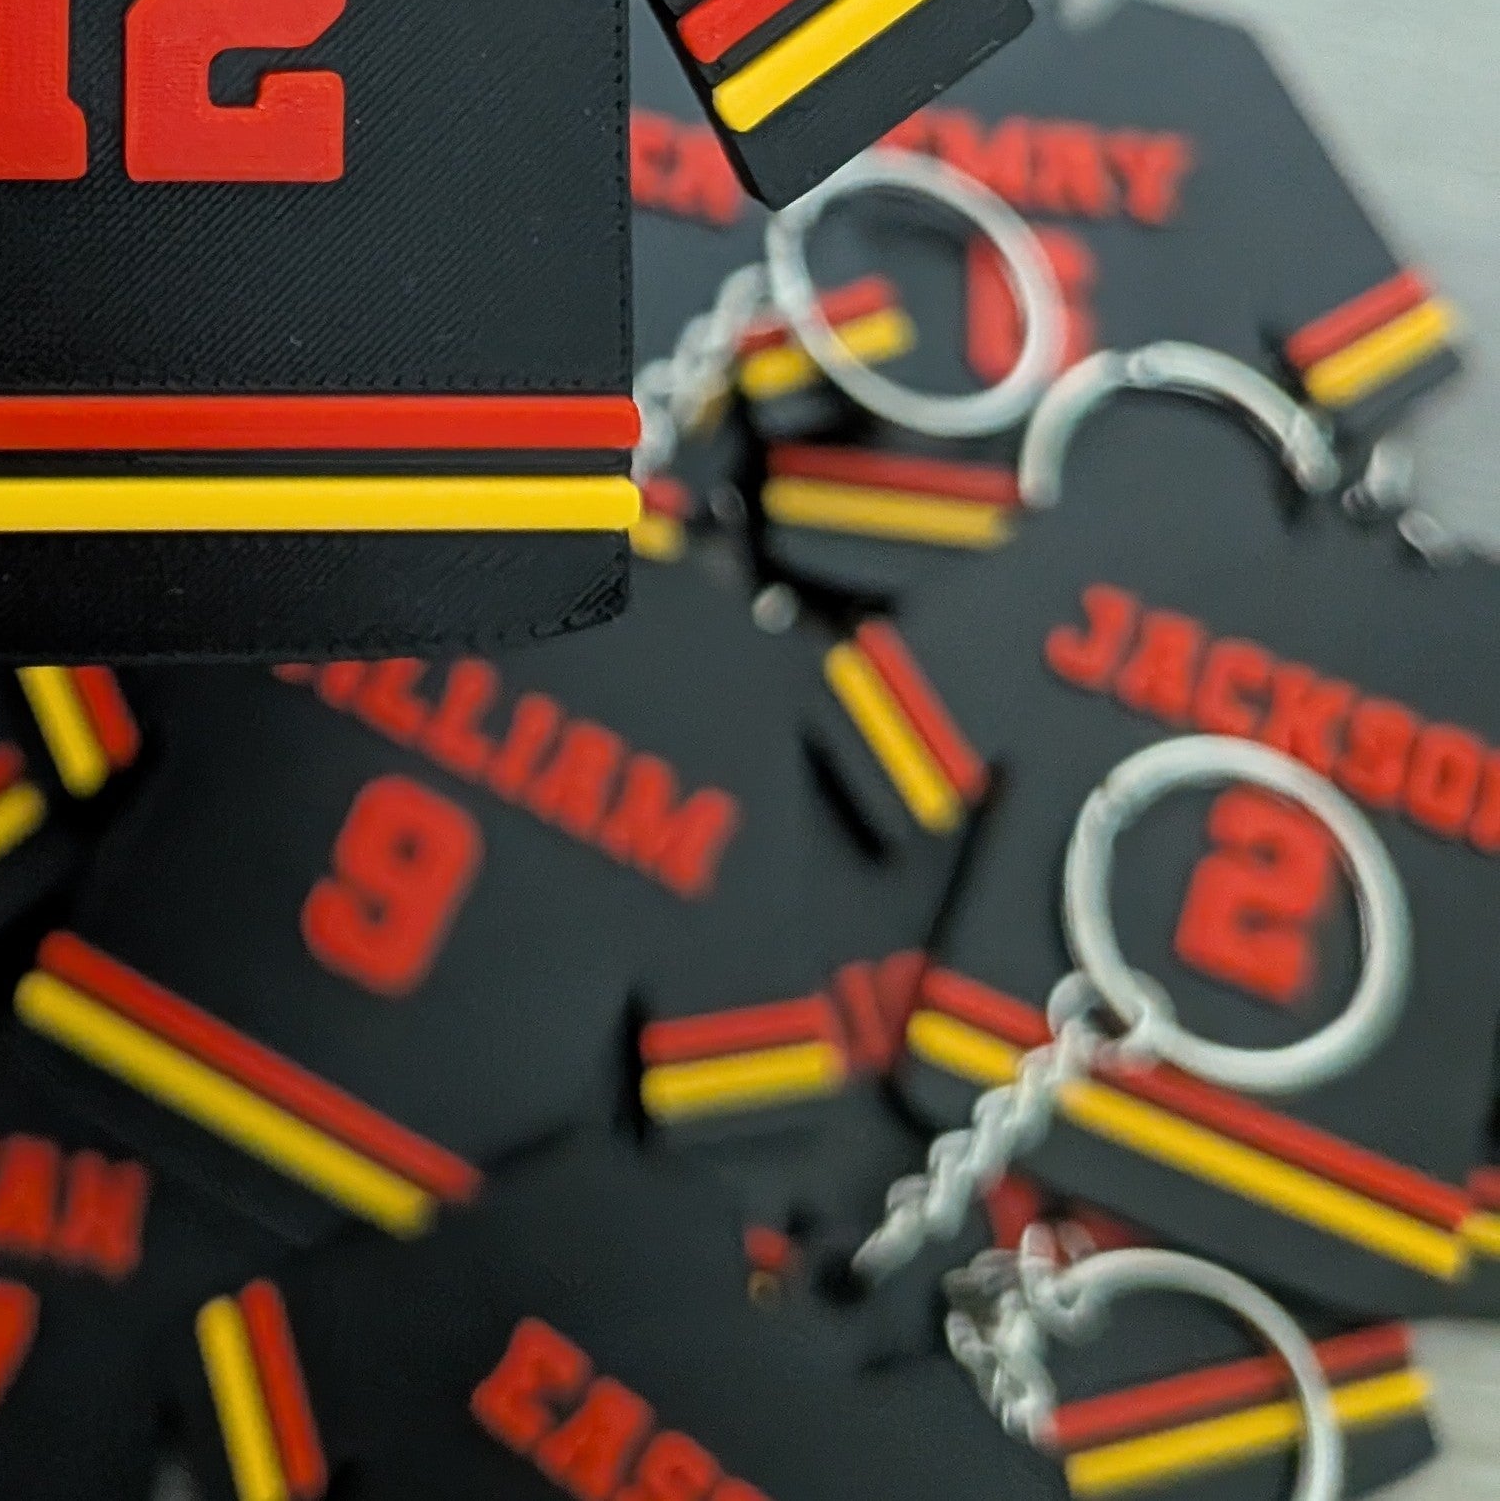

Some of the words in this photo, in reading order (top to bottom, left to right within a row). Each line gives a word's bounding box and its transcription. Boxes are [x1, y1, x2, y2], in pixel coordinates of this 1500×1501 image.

[278, 657, 734, 893] LLIAM
[302, 775, 480, 991] 9
[1175, 784, 1342, 1003] 2
[471, 1319, 769, 1501] EAS
